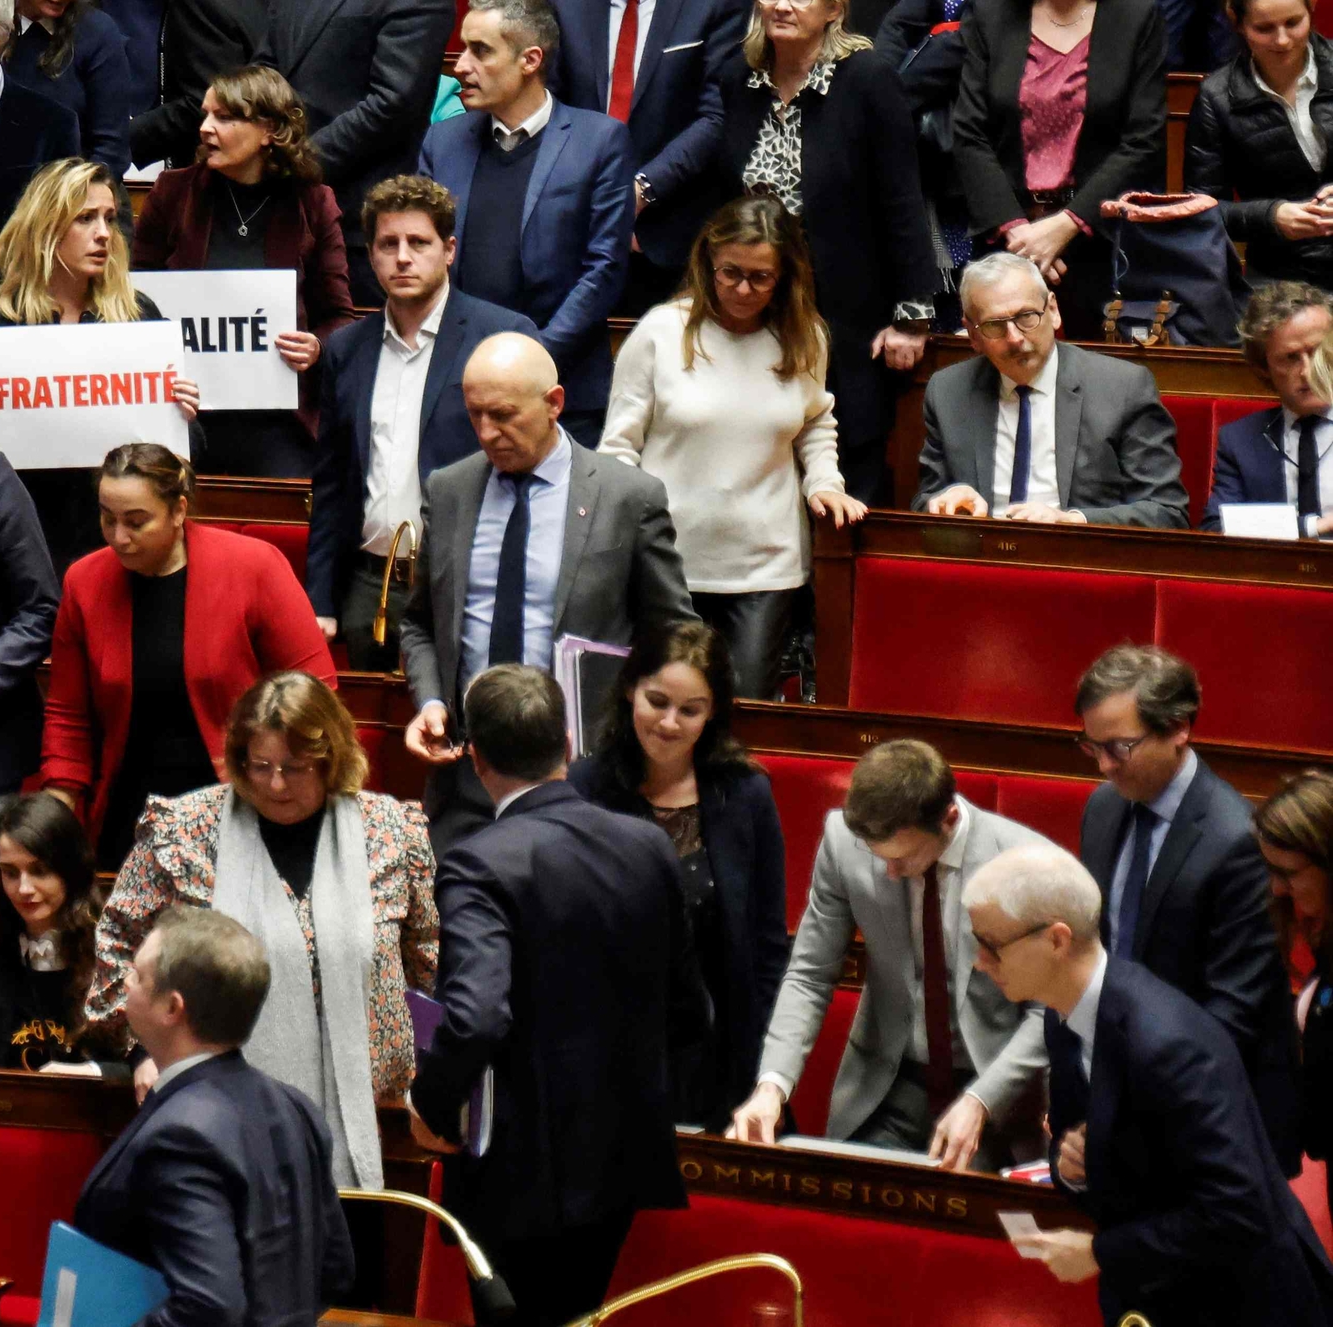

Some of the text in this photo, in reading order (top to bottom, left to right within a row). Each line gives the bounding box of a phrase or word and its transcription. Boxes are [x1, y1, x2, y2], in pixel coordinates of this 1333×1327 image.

[181, 308, 269, 353] ALITÉ
[997, 541, 1017, 552] 416
[860, 734, 879, 744] 412
[679, 1161, 969, 1218] OMMISSIONS
